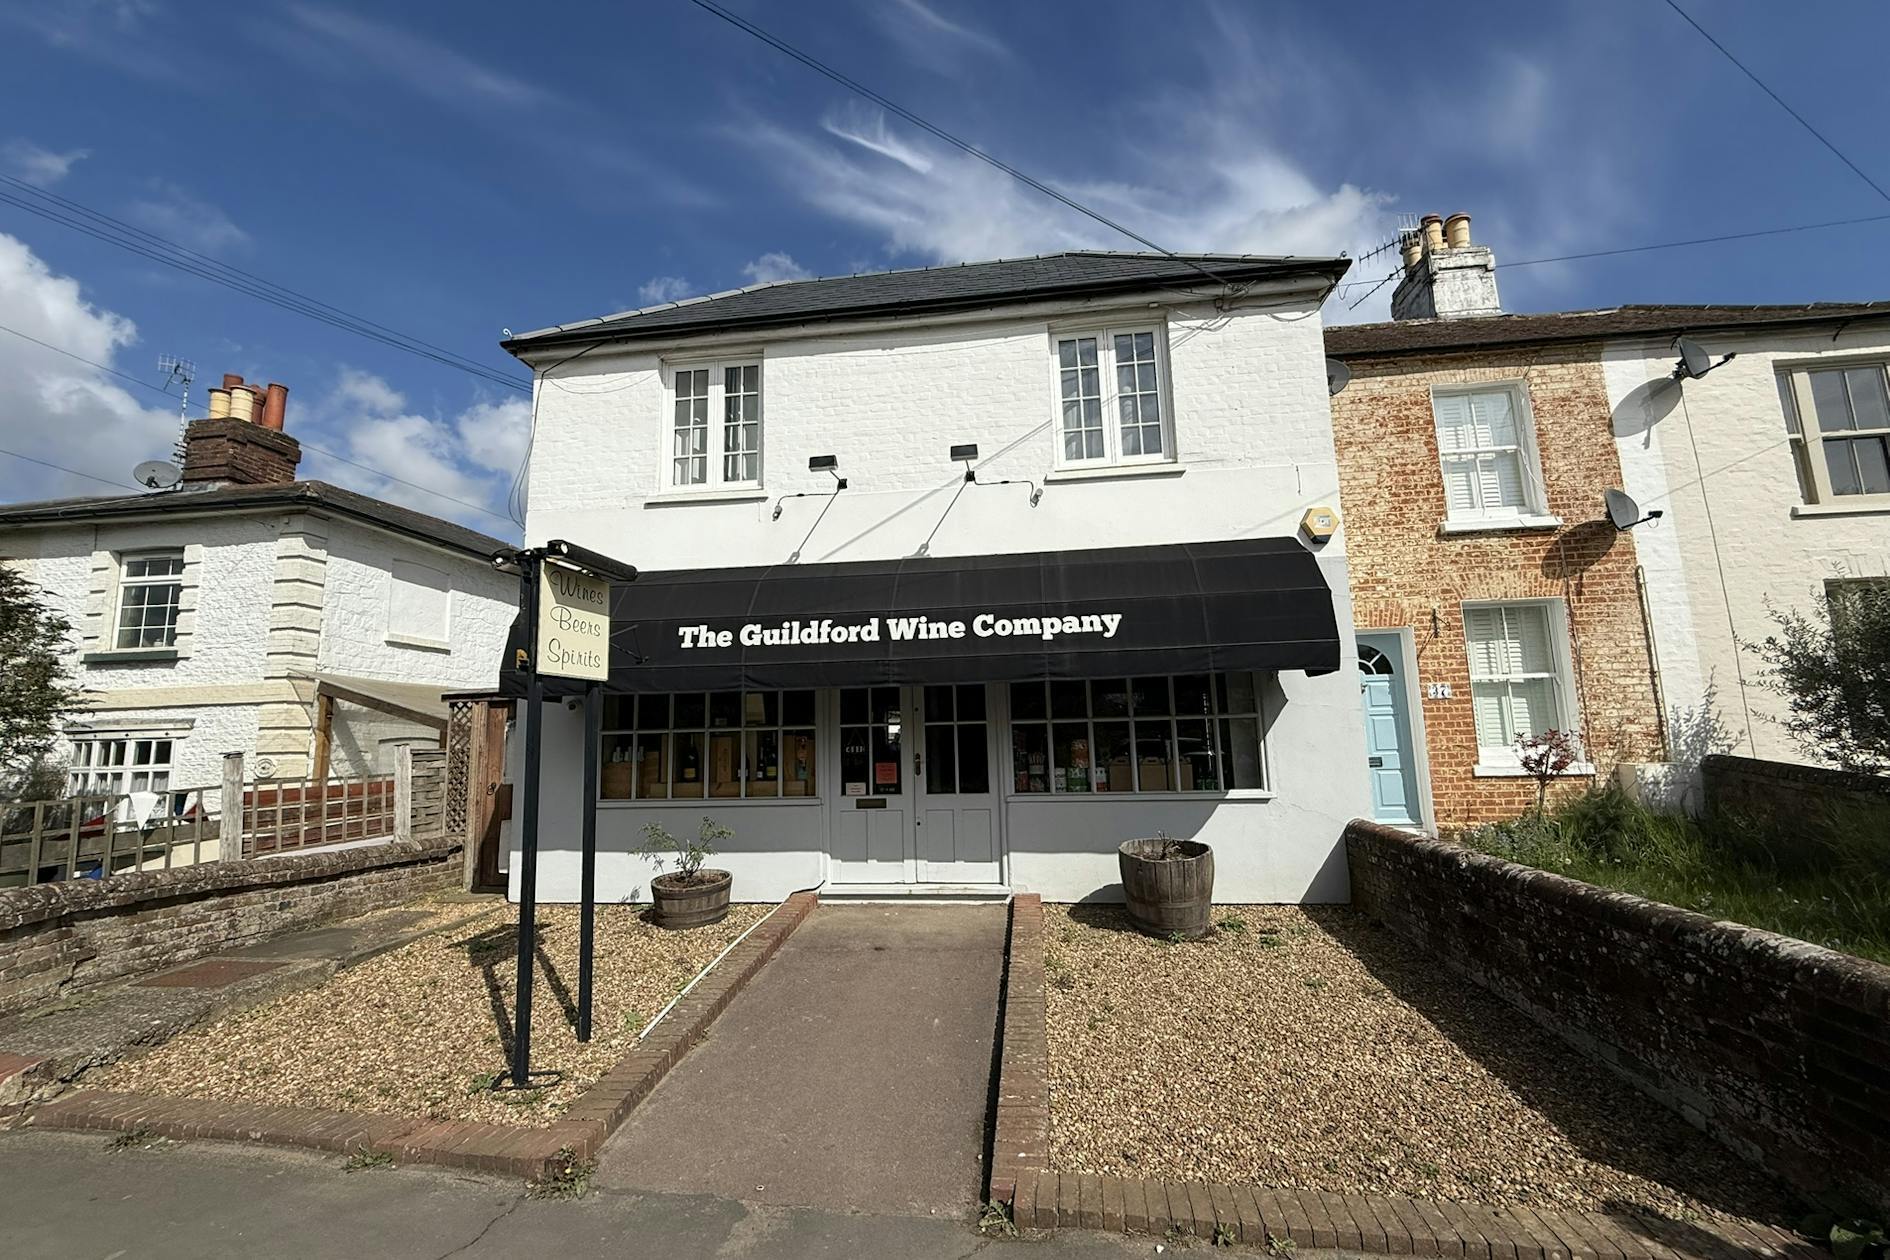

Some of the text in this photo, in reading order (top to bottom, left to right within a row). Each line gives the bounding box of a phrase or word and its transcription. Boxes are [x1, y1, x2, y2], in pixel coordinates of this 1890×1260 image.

[550, 571, 603, 604] Wines
[550, 606, 601, 637] Beers
[678, 613, 1122, 648] The Guildford Wine Company
[547, 638, 601, 670] Spirits
[1432, 684, 1446, 698] 37
